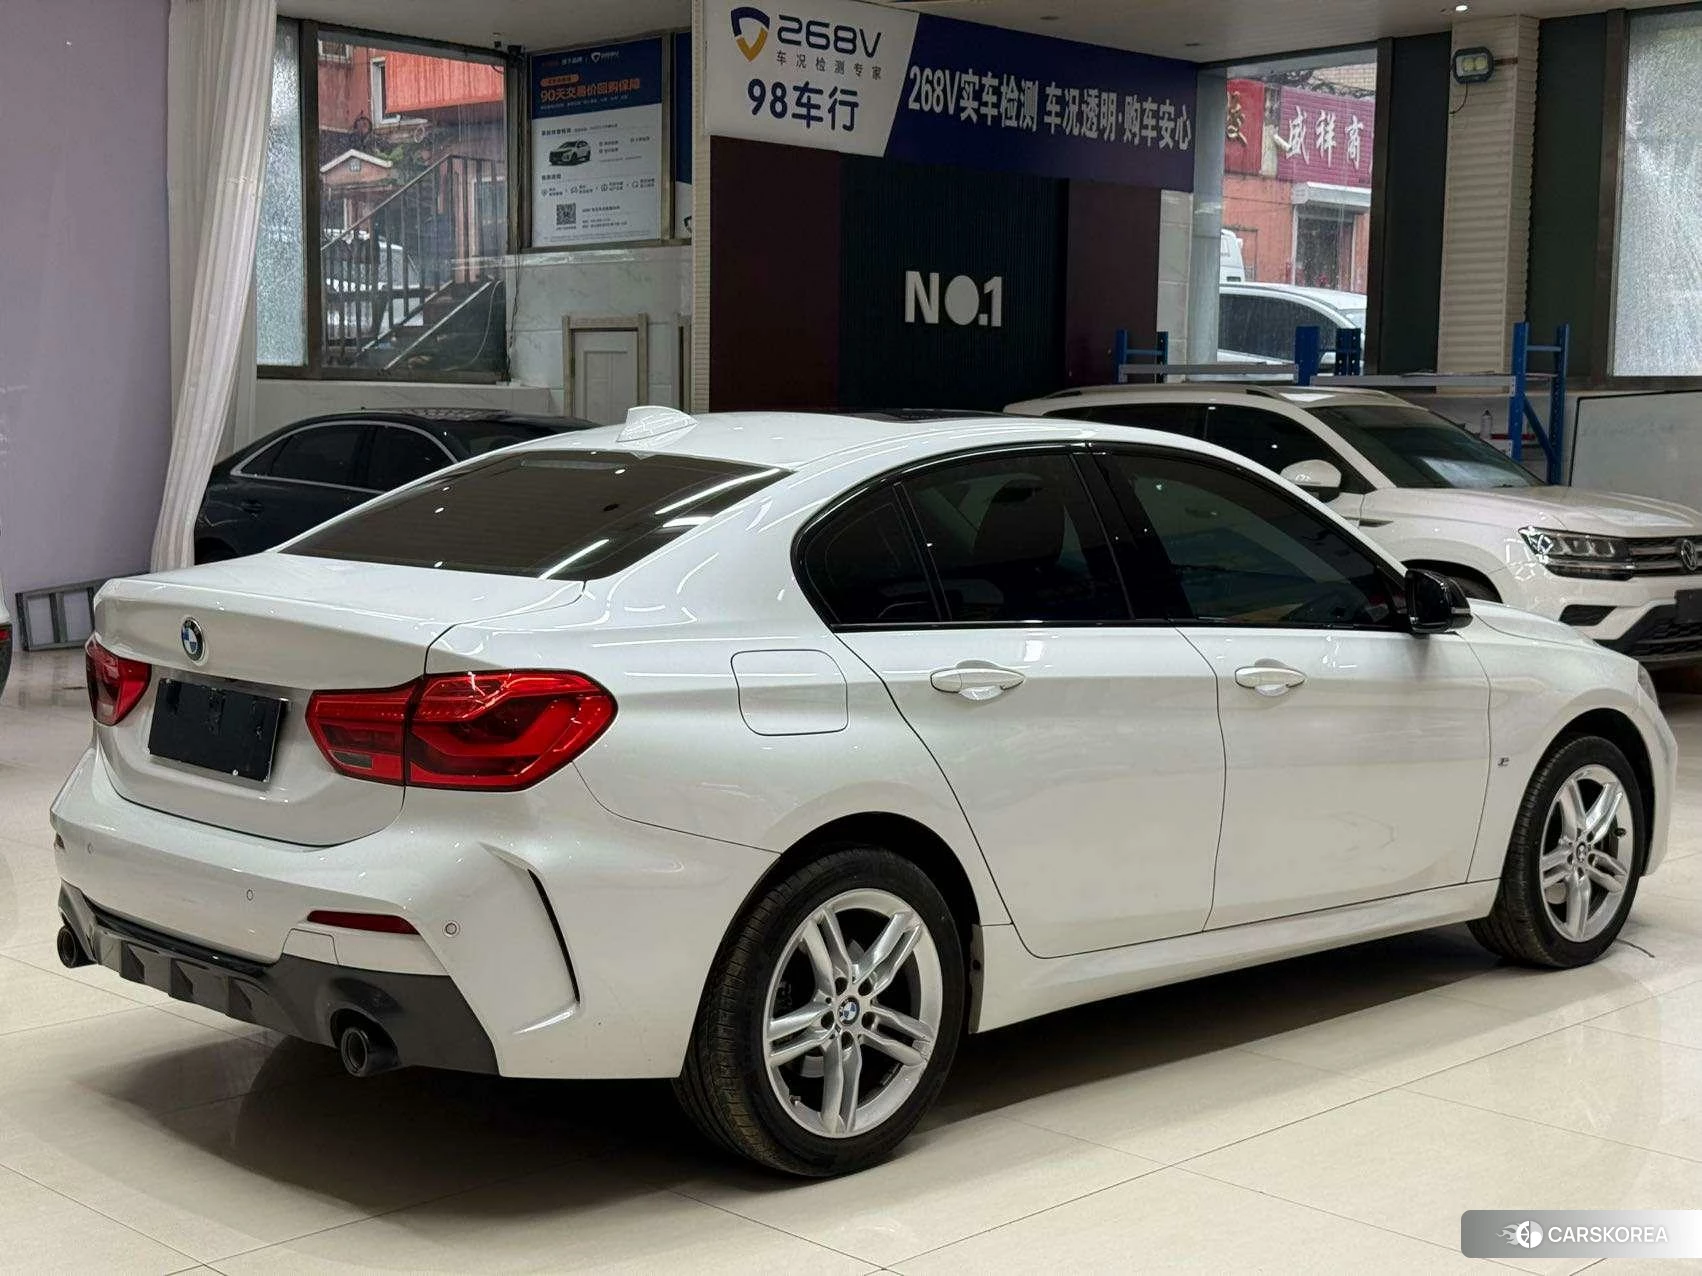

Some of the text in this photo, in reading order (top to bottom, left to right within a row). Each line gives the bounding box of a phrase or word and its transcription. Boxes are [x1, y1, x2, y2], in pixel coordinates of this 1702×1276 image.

[777, 14, 882, 58] 268V
[776, 50, 882, 81] 车况检测专家
[748, 78, 859, 132] 98车行
[908, 65, 1039, 132] 268V实车检测
[905, 270, 1002, 327] NO.1
